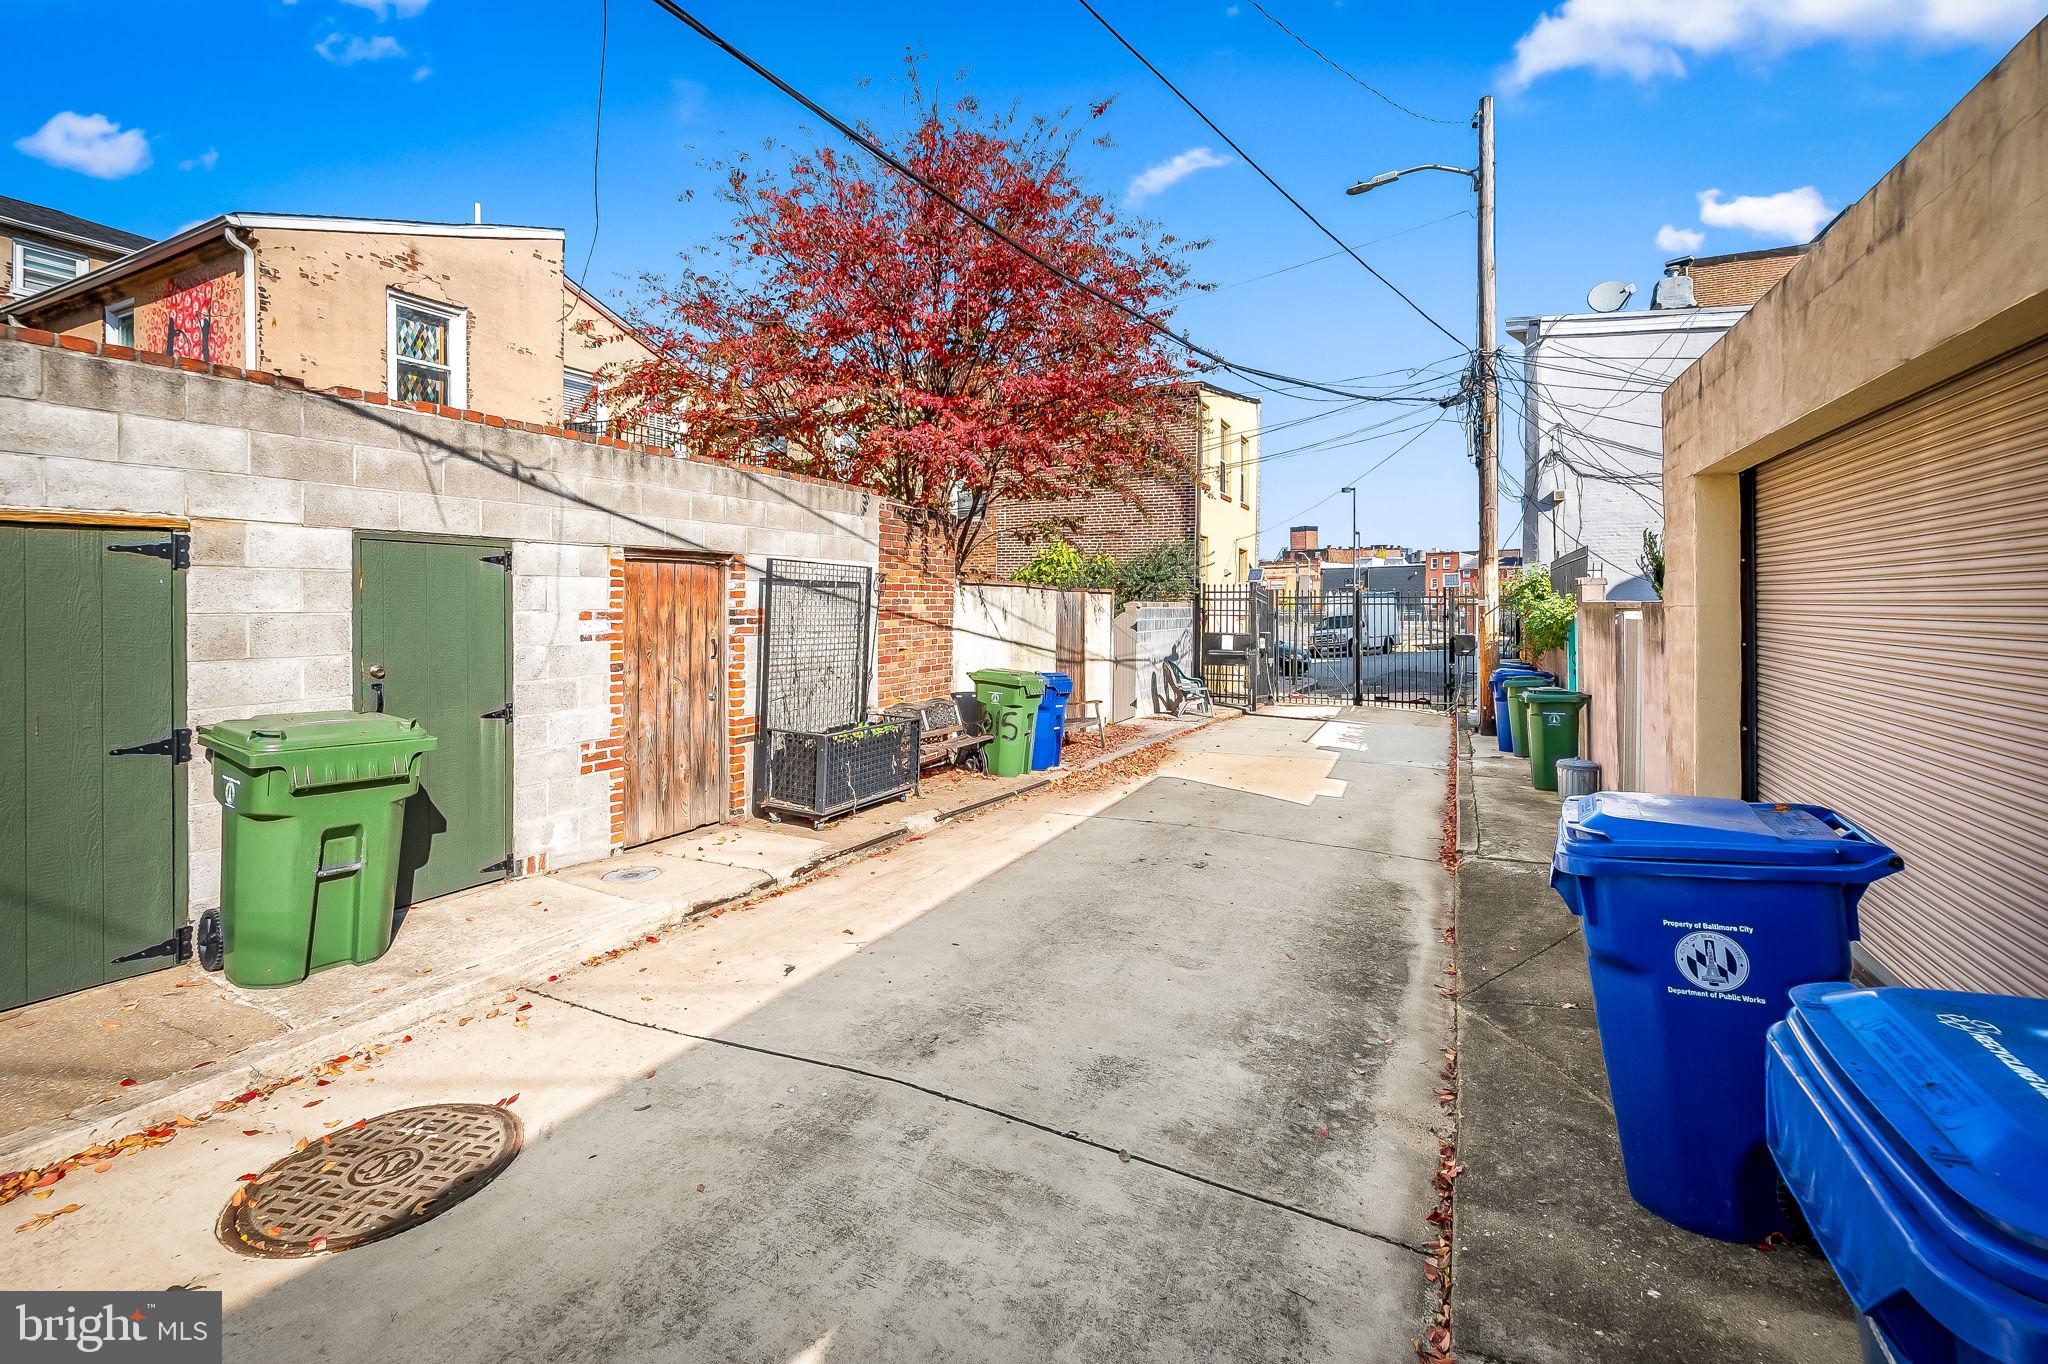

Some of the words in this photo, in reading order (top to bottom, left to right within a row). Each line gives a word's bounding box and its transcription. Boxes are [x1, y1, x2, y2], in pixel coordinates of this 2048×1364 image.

[1663, 919, 1693, 929] Property
[1702, 923, 1738, 932] Baltimore
[1739, 925, 1754, 934] City
[1667, 987, 1709, 997] Department
[1719, 993, 1741, 1002] Public
[1741, 995, 1766, 1004] Works
